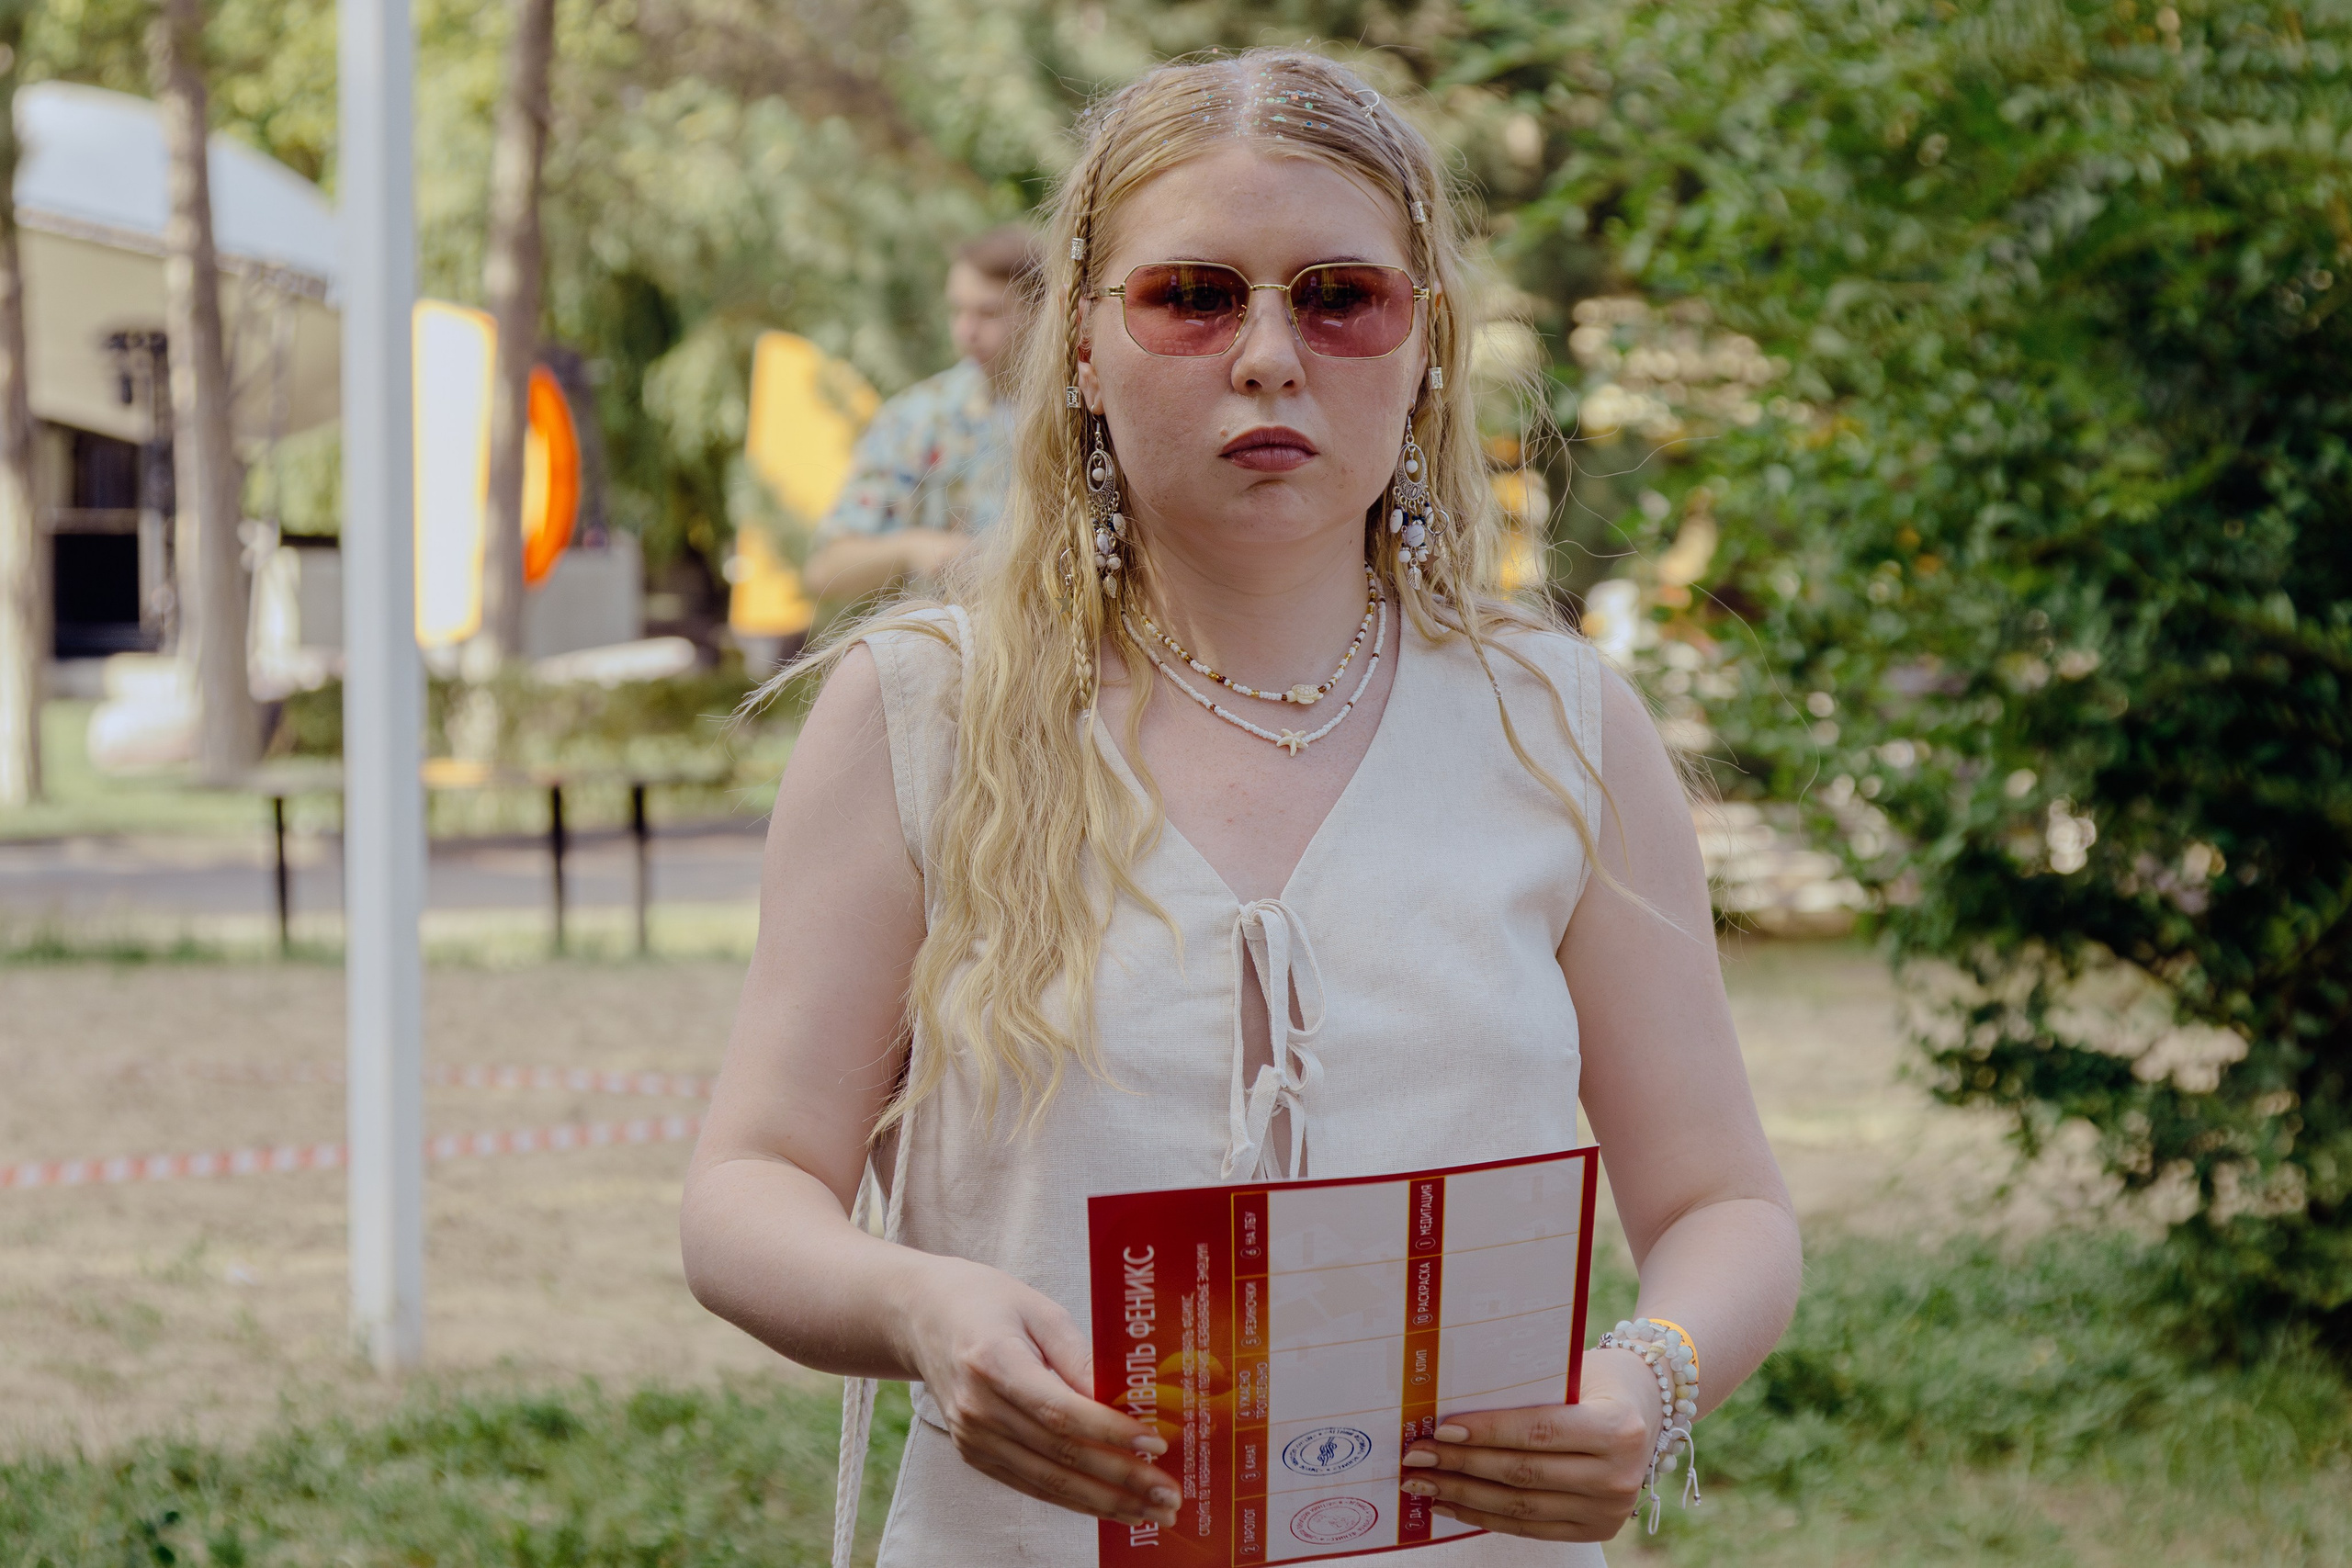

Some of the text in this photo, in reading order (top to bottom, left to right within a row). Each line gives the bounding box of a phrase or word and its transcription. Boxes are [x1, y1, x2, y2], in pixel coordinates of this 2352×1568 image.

[1419, 1183, 1434, 1235] МЕДИТАЦИЯ
[1245, 1232, 1257, 1246] НА
[1123, 1245, 1158, 1338] ФЕНИКС
[1245, 1281, 1257, 1336] РЕЗИНОЧКИ
[1417, 1261, 1430, 1313] РАСКРАСКА
[1415, 1348, 1428, 1373] КЛИП
[1238, 1371, 1252, 1408] УЖАСНО
[1255, 1361, 1269, 1419] ТРОГАТЕЛЬНО
[1244, 1444, 1257, 1470] КАНАТ
[1408, 1507, 1422, 1518] ДА
